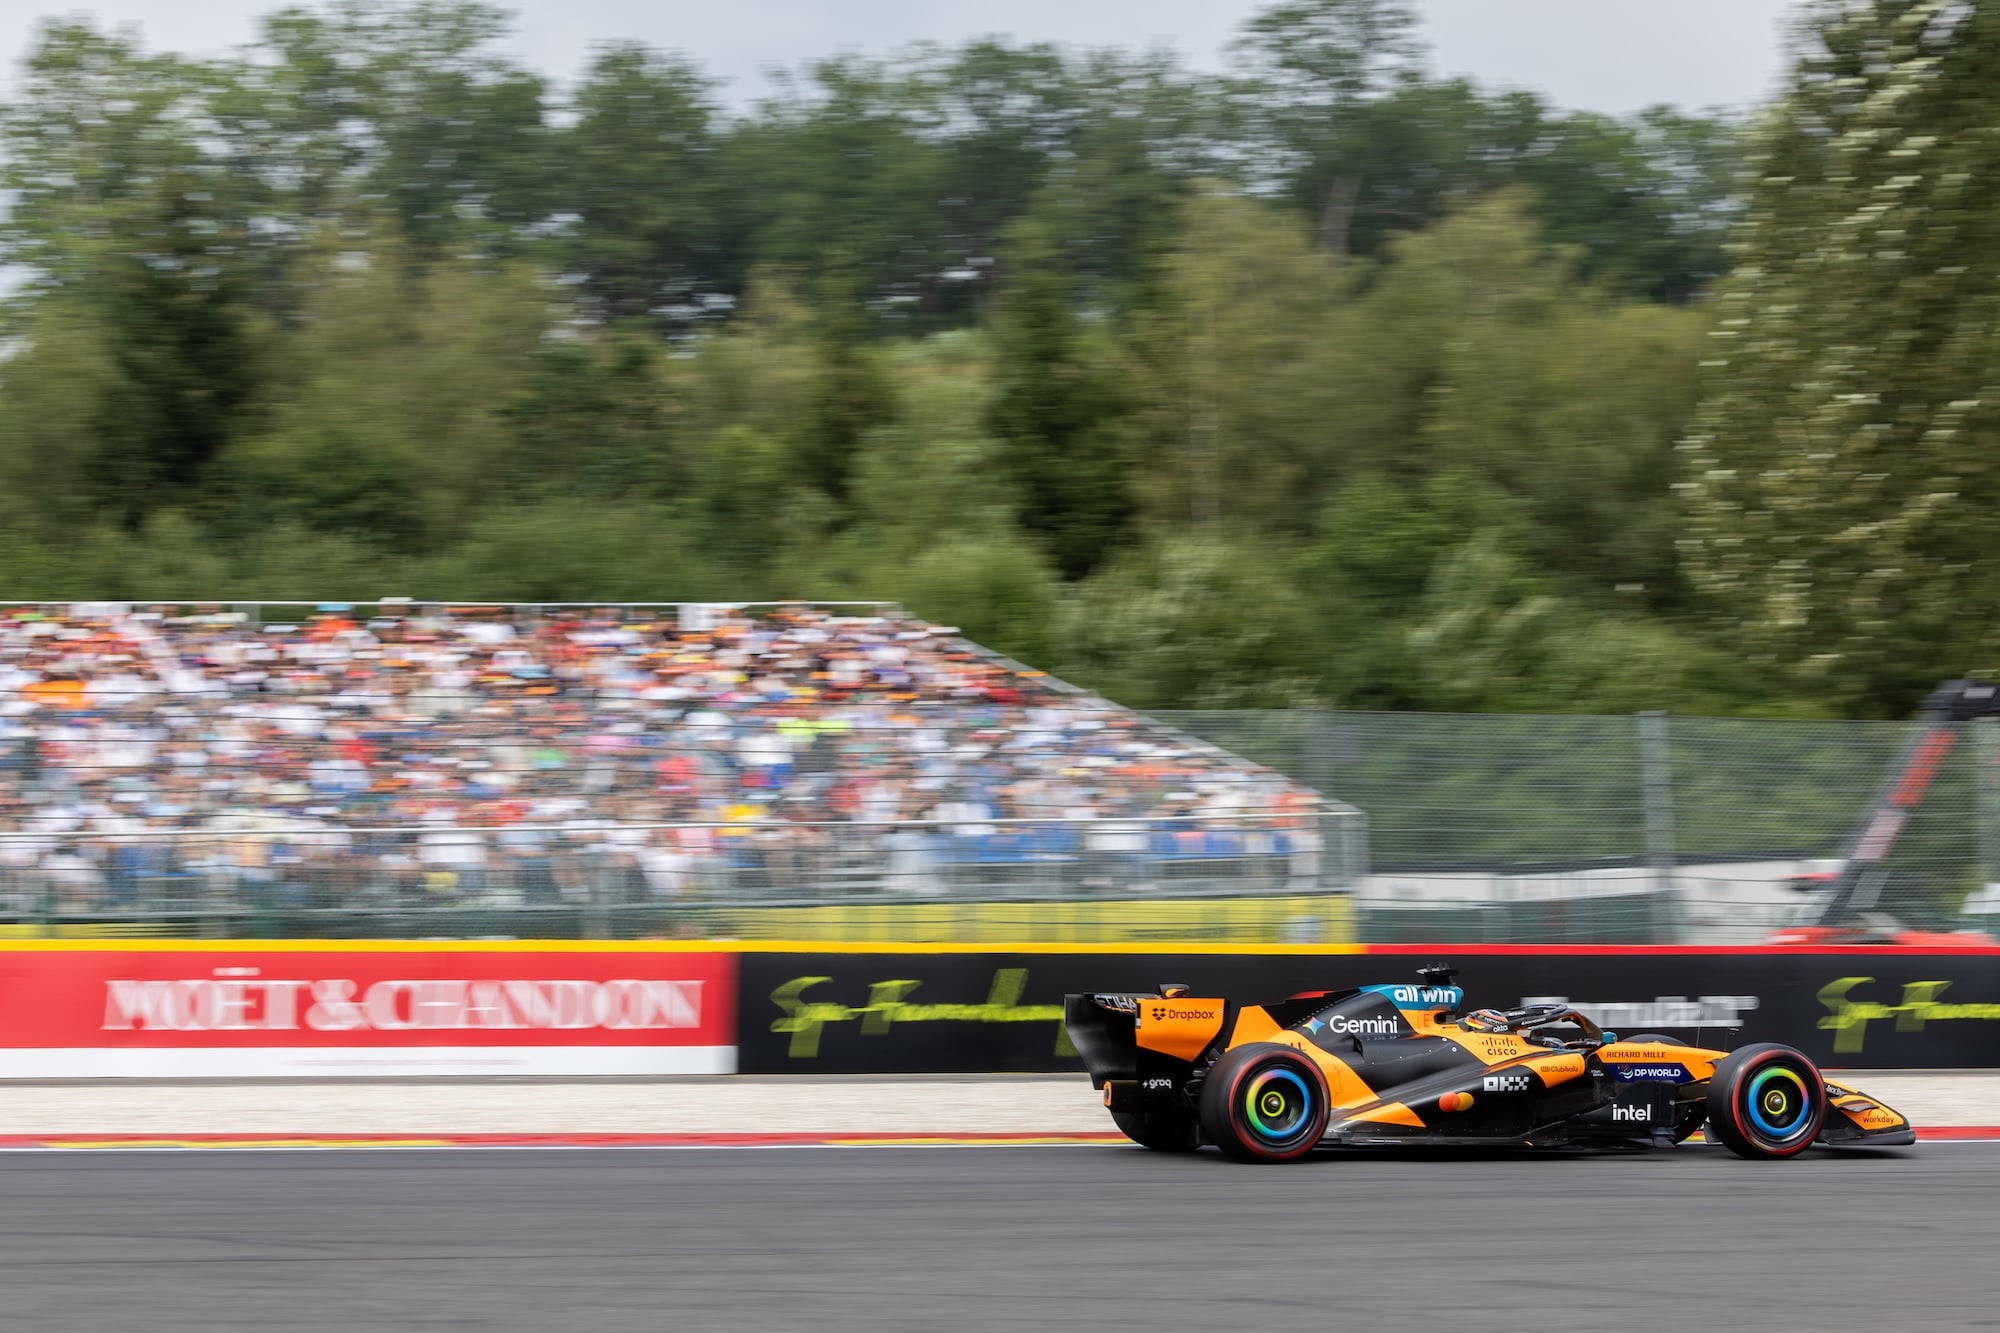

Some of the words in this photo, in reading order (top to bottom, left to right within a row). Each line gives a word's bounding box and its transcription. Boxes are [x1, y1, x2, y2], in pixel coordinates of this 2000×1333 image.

[1393, 985, 1418, 1002] all
[1421, 988, 1456, 1003] win
[1168, 1009, 1215, 1021] Dropbox
[1329, 1014, 1398, 1034] Gemini
[1492, 1025, 1509, 1033] okta
[1487, 1048, 1517, 1056] CISCO
[1634, 1068, 1648, 1077] DP
[1648, 1068, 1681, 1077] WORLD
[1148, 1078, 1172, 1089] groq
[1483, 1076, 1530, 1092] OKX
[1612, 1104, 1652, 1121] intel
[1862, 1115, 1895, 1124] workday
